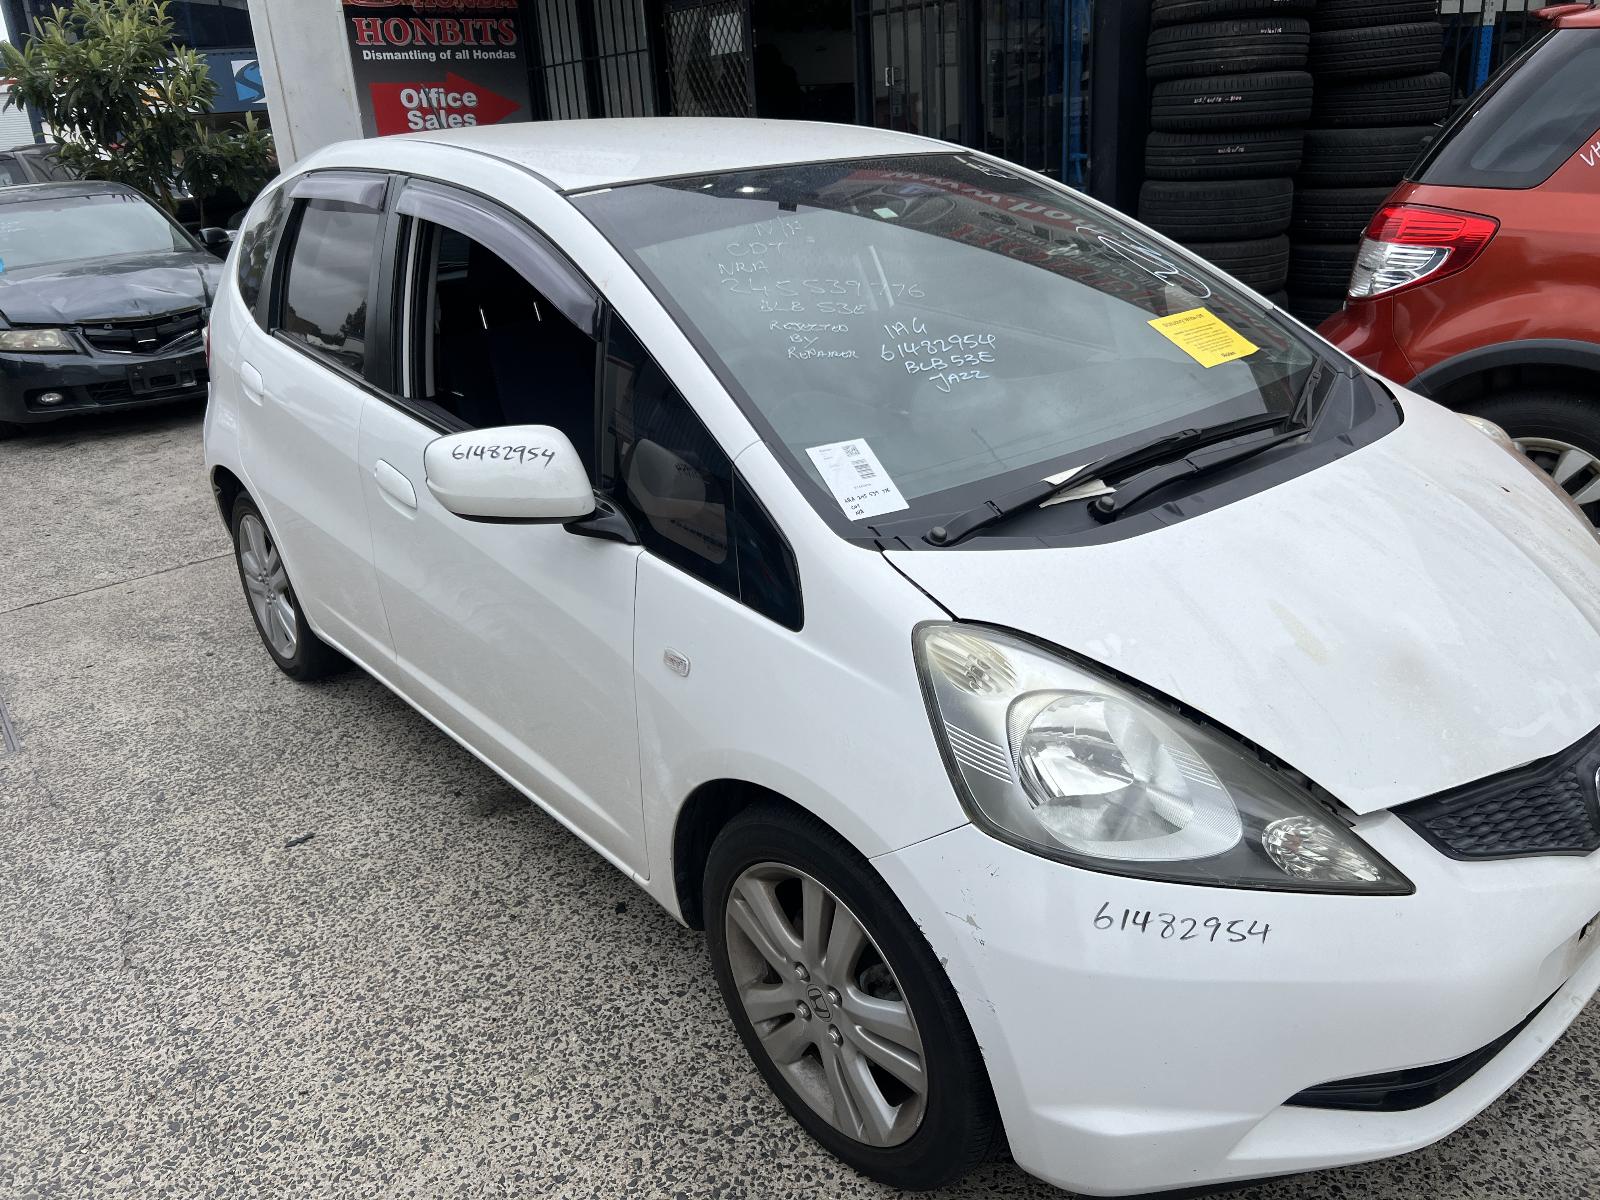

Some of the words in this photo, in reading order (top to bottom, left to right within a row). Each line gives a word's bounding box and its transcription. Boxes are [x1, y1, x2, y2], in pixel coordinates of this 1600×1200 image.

[352, 17, 517, 46] HONBITS
[362, 50, 436, 62] Dismantling
[439, 50, 452, 60] of
[455, 50, 470, 60] all
[473, 50, 517, 60] Hondas
[400, 87, 477, 109] Office
[407, 110, 477, 130] Sales
[881, 334, 996, 361] 61482954
[452, 444, 555, 468] 61482954
[1093, 901, 1273, 944] 61482954
